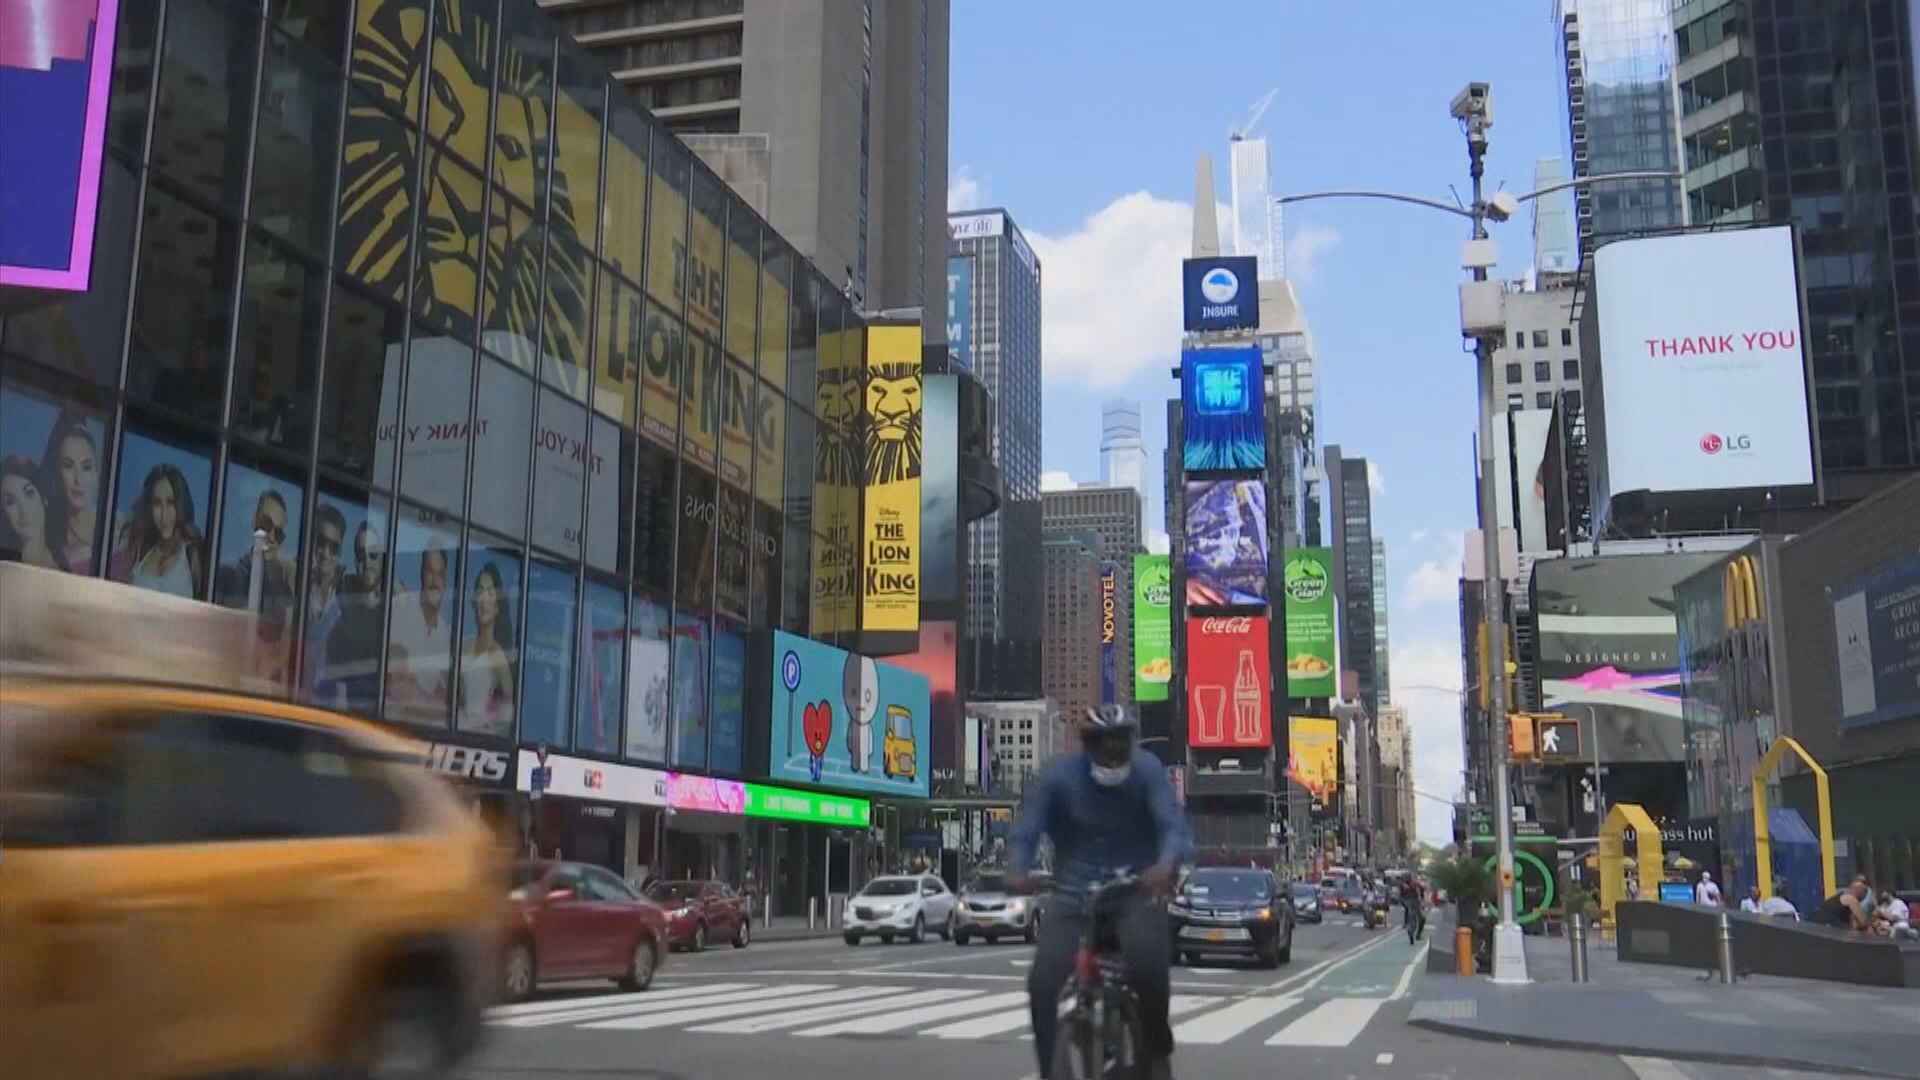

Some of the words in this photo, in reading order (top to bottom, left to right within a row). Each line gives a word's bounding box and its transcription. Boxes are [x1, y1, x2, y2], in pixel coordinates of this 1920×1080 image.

[672, 238, 721, 318] THE
[1202, 305, 1239, 318] INSURE
[1645, 335, 1734, 357] THANK
[1741, 329, 1795, 350] YOU
[607, 257, 696, 401] LION
[701, 327, 776, 452] KING
[1726, 435, 1751, 450] LG
[874, 523, 904, 538] THE
[869, 540, 910, 565] LION
[866, 566, 916, 596] KING
[1288, 578, 1324, 589] Green
[1144, 585, 1170, 596] Gree
[1291, 587, 1324, 599] Giant
[1102, 571, 1114, 644] NOVOTEL
[1565, 652, 1641, 664] DESIGNED
[1650, 652, 1667, 662] BY
[1687, 825, 1714, 841] hut
